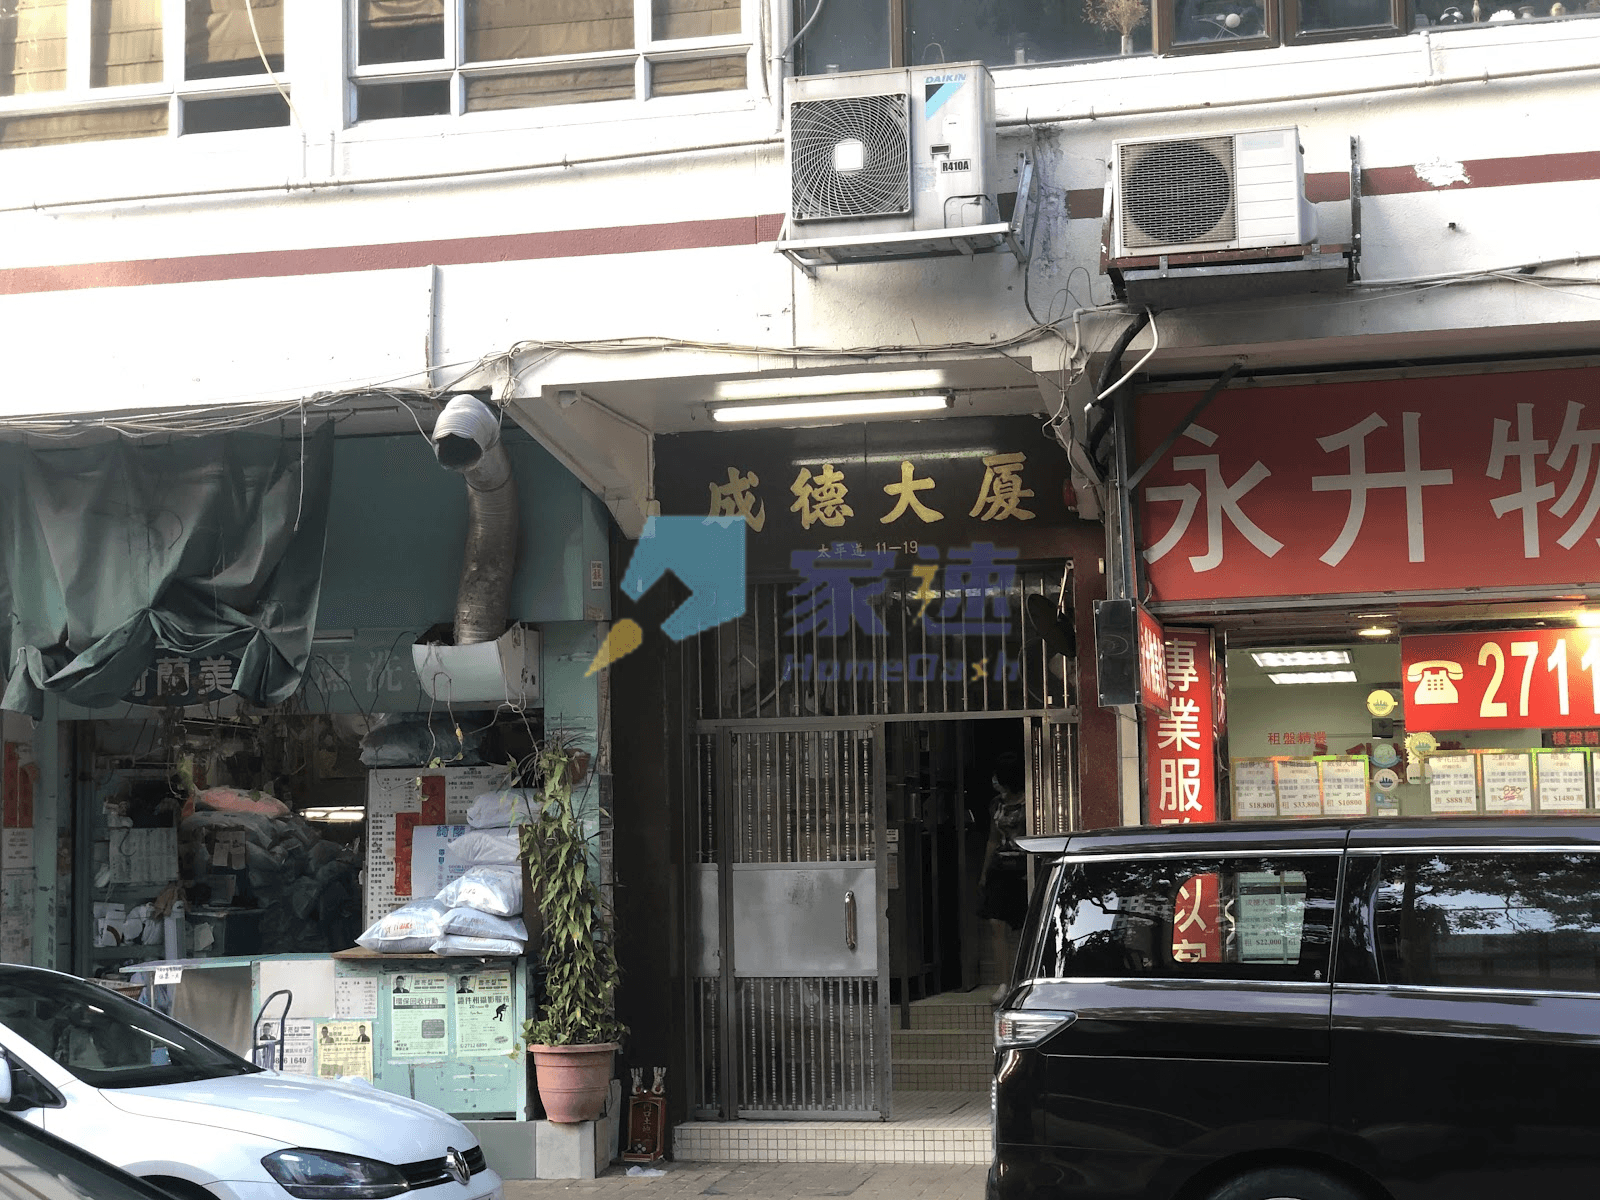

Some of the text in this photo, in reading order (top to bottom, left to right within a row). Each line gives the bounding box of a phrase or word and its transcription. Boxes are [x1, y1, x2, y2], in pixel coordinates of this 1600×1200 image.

[925, 73, 966, 84] DAIKIN
[942, 160, 969, 172] R410A
[1143, 399, 1600, 574] 永升物
[816, 543, 867, 560] 太平道
[131, 655, 233, 697] 蘭美
[1478, 637, 1600, 718] 2711
[1158, 637, 1203, 824] 專業服
[1267, 731, 1327, 745] 租盤精選
[290, 1056, 307, 1064] 1640
